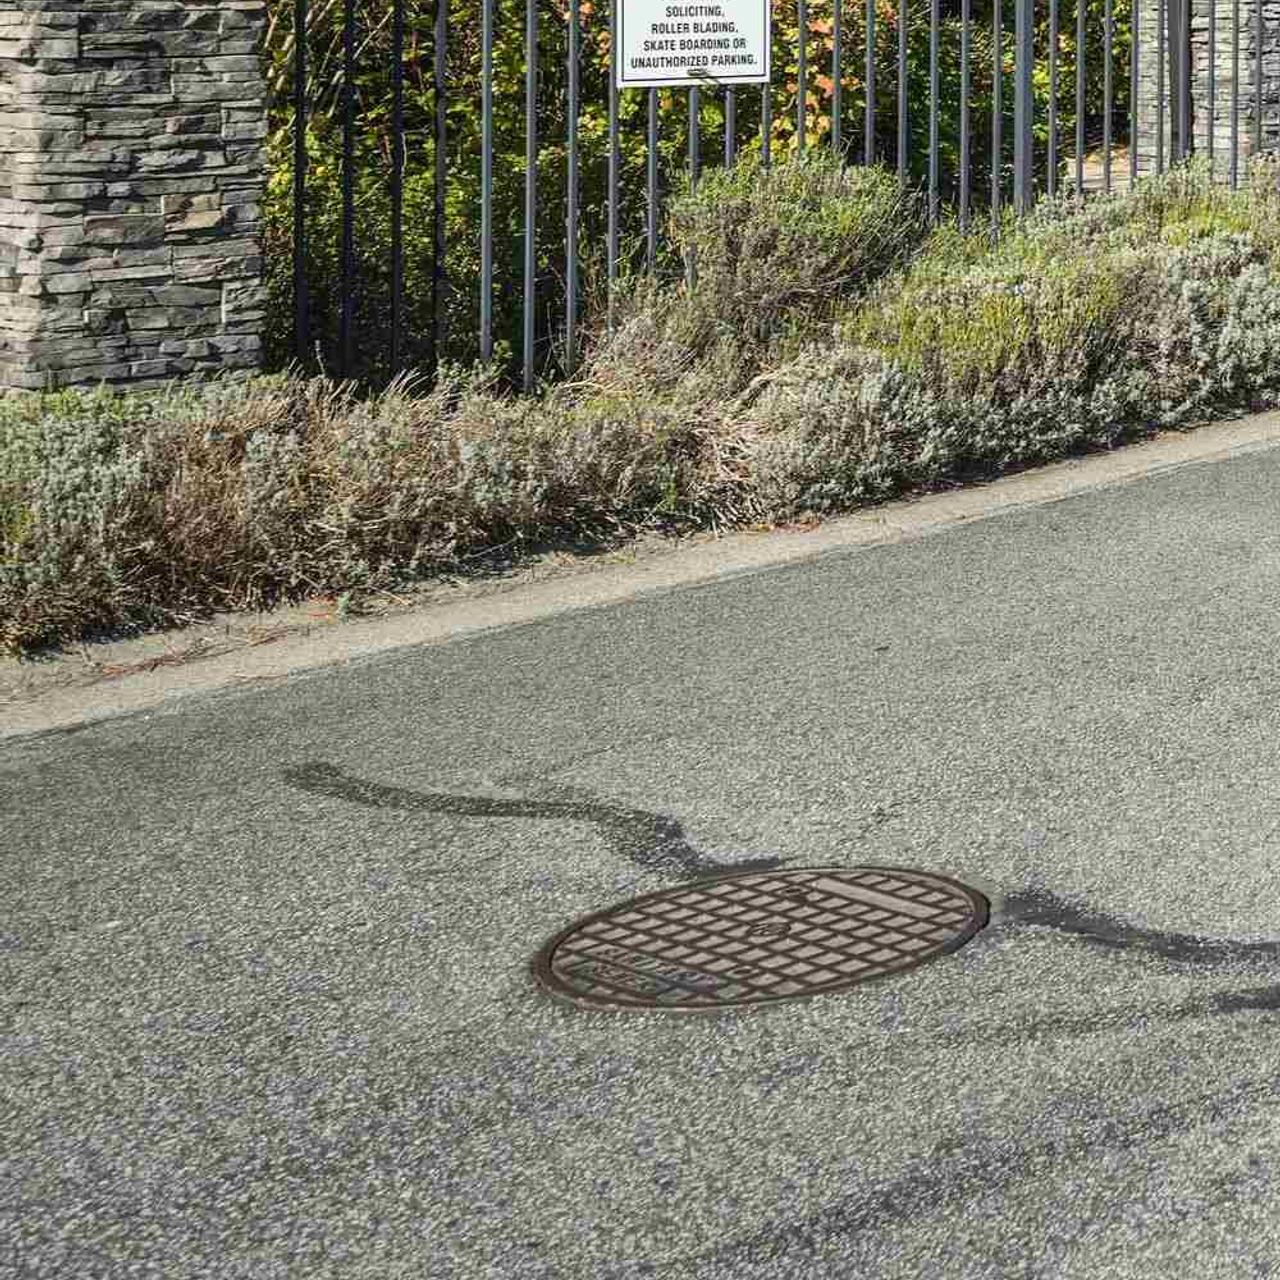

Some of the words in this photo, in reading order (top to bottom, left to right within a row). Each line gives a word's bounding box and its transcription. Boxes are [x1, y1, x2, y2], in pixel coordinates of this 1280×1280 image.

[651, 23, 690, 34] ROLLER
[643, 40, 676, 51] SKATE
[679, 38, 730, 50] BOARDING
[733, 38, 747, 48] OR
[631, 55, 709, 69] UNAUTHORIZED
[711, 53, 758, 66] PARKING.
